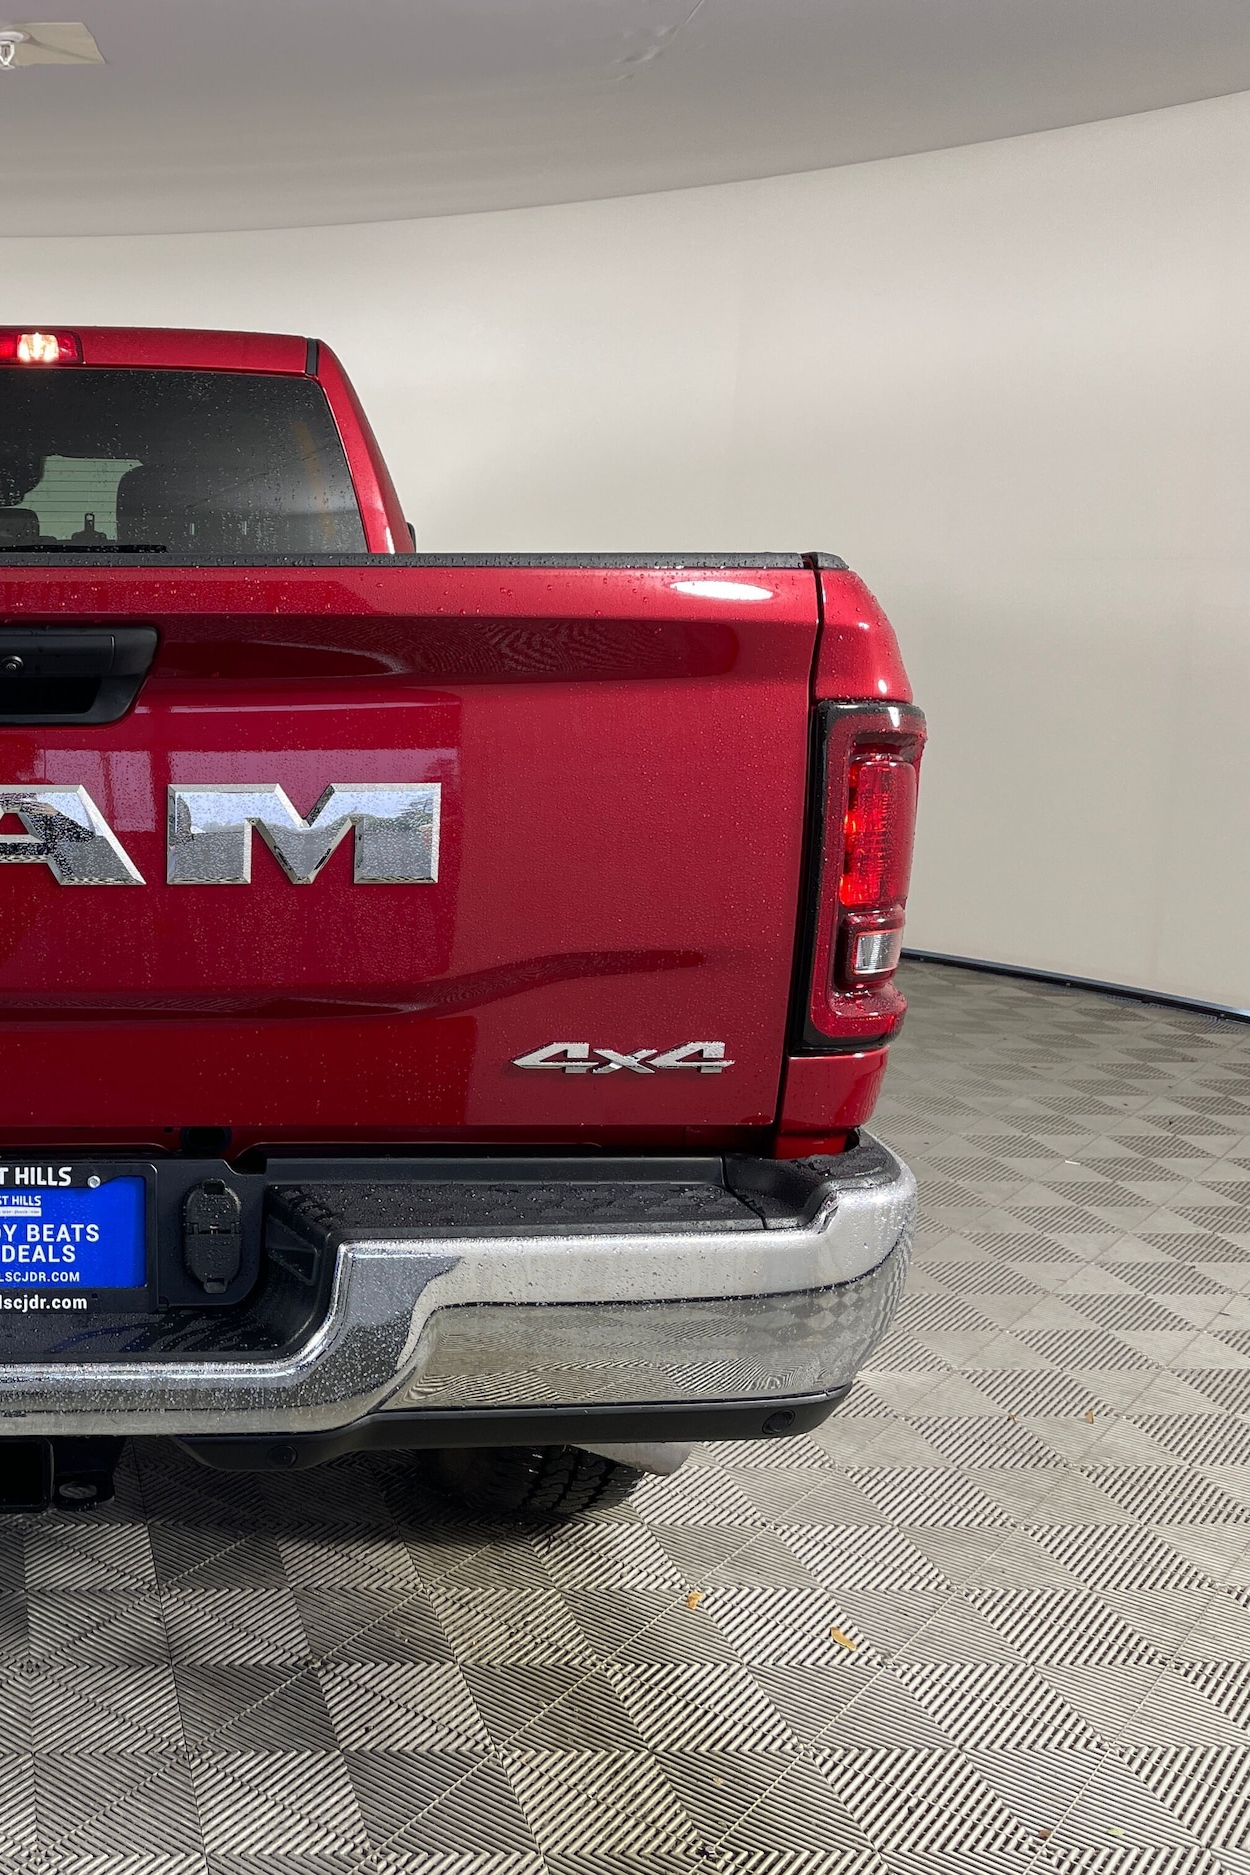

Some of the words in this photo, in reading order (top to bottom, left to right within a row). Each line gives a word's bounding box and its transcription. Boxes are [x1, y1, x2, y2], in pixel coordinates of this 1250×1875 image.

[510, 1041, 736, 1074] 4x4
[14, 1166, 72, 1187] HILLS
[11, 1195, 41, 1206] HILLS
[26, 1223, 100, 1243] BEATS
[1, 1245, 76, 1263] DEALS
